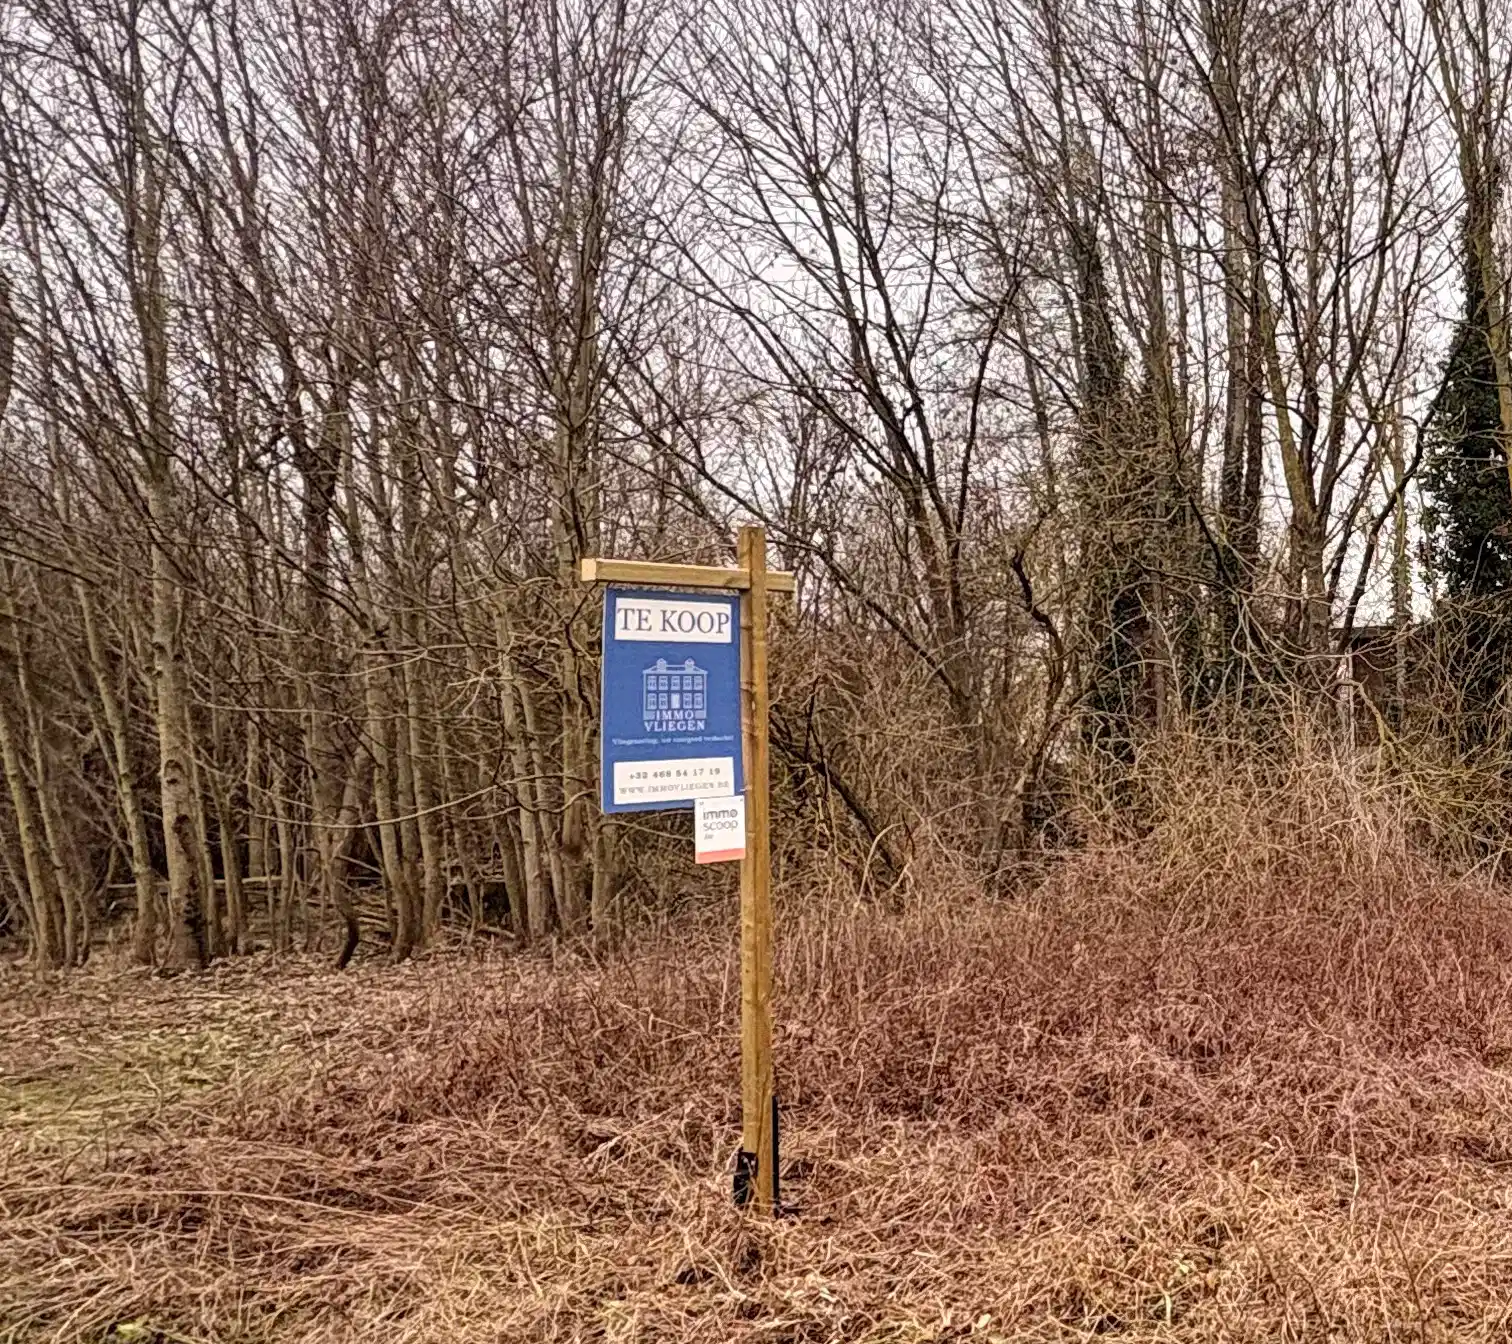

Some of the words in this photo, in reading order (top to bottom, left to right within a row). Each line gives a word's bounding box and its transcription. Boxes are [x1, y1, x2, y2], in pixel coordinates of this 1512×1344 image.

[617, 608, 652, 632] TE
[660, 610, 730, 634] KOOP
[656, 710, 694, 721] IMMO
[644, 720, 705, 732] VLIEGEN
[693, 769, 704, 777] 17
[703, 809, 738, 821] immo
[703, 820, 738, 832] scoop
